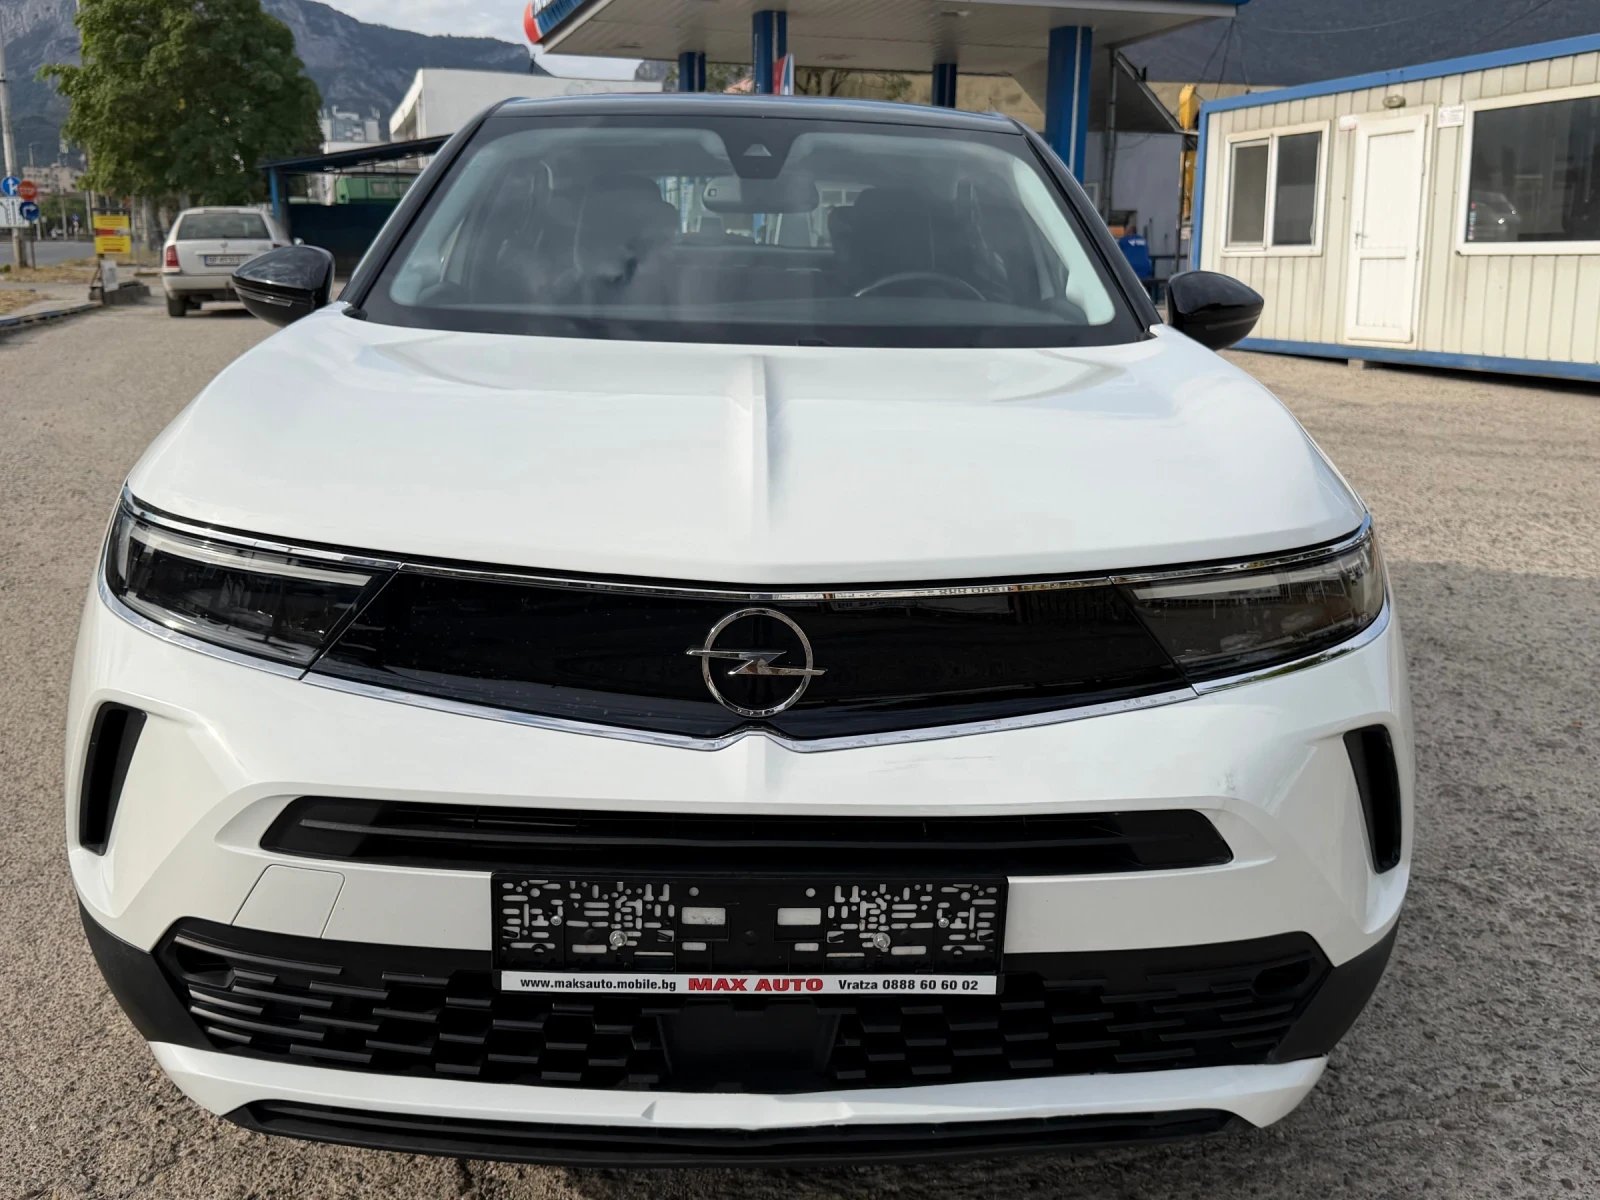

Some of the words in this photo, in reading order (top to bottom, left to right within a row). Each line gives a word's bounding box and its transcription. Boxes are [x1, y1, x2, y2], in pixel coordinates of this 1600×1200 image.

[520, 978, 677, 991] www.maksauto.mobile.bg
[688, 977, 748, 992] MAX
[754, 977, 824, 992] AUTO
[838, 979, 878, 990] Vratza
[882, 979, 916, 990] 0888
[919, 980, 937, 990] 60
[942, 980, 957, 990] 60
[961, 980, 978, 990] 02
